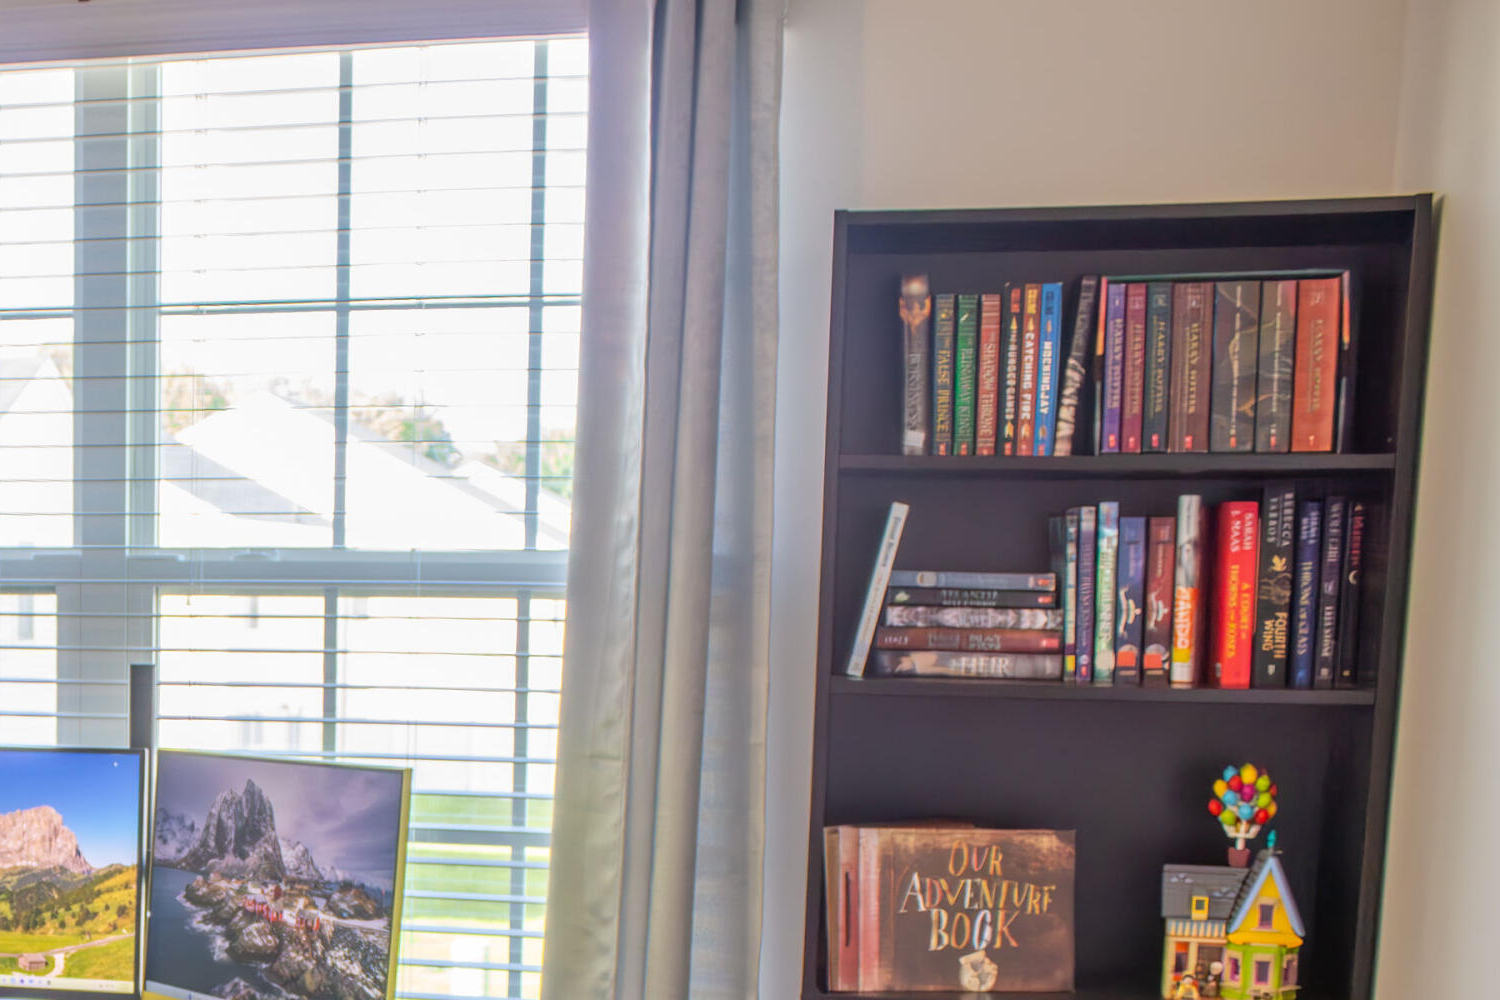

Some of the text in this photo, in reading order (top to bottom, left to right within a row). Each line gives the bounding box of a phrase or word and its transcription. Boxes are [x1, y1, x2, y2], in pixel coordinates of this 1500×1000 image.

[982, 343, 996, 390] SHADOW
[1021, 332, 1035, 420] CATCHING FIRE
[1040, 341, 1052, 414] MOCKINGJAY
[979, 394, 994, 437] THRONE
[1230, 519, 1241, 553] MAAS
[1242, 513, 1253, 551] SARAH
[1262, 620, 1274, 652] WING
[1274, 612, 1288, 659] FOURTH
[948, 839, 1003, 877] OUR
[897, 871, 1057, 915] ADVENTURE
[928, 907, 1021, 952] BOOK
